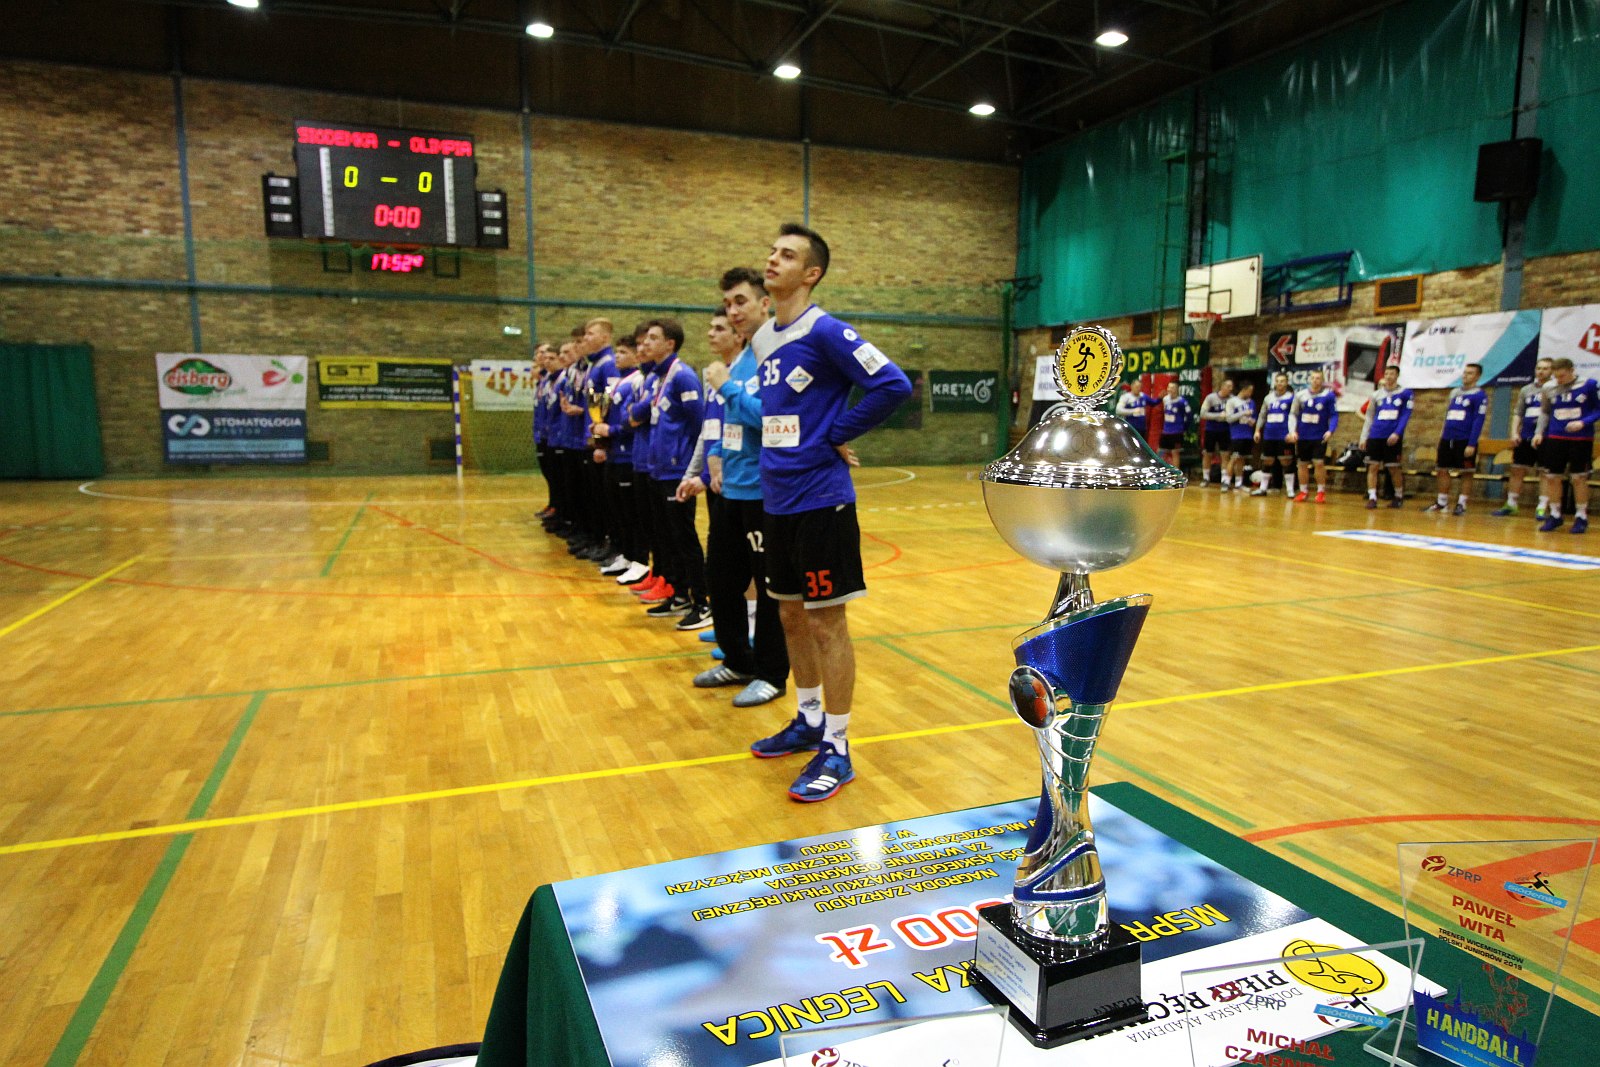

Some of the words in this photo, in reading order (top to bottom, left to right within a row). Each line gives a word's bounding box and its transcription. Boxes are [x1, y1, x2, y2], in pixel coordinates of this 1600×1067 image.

[344, 166, 358, 187] 0
[418, 171, 432, 192] 0
[374, 204, 421, 228] 0:00
[166, 368, 231, 388] eisberg
[763, 358, 781, 387] 35
[932, 383, 974, 396] KRĘTA
[213, 417, 301, 427] STOMATOLOGIA
[746, 530, 765, 552] 12
[805, 569, 833, 597] 35
[896, 829, 918, 838] W
[902, 821, 1028, 848] MŁODZIEŻOWEJ
[963, 841, 993, 852] ZA
[799, 839, 851, 856] ROKU
[885, 847, 966, 868] WYBITNE
[764, 860, 883, 889] OSIĄGNIĘCIA
[773, 852, 852, 875] RĘCZNEJ
[1447, 865, 1483, 884] ZPRP
[665, 866, 771, 895] MĘŻCZYZN
[830, 867, 921, 894] ZWIĄZKU
[908, 867, 999, 893] NAGRODA
[692, 893, 782, 921] RĘCZNEJ
[782, 885, 834, 903] PIŁKI
[814, 886, 910, 912] ZARZĄDU
[1120, 903, 1232, 943] MSPR
[1452, 895, 1516, 928] PAWEŁ
[1438, 927, 1465, 943] TRENER
[1438, 934, 1463, 948] POLSKI
[1458, 914, 1506, 943] WITA
[821, 927, 888, 966] zł
[702, 979, 907, 1046] LEGNICA
[1126, 1015, 1202, 1043] AKADEMIA
[1426, 1008, 1524, 1066] HANDBALL
[1224, 1045, 1328, 1067] CZARN
[1246, 1027, 1335, 1061] MICHAŁ
